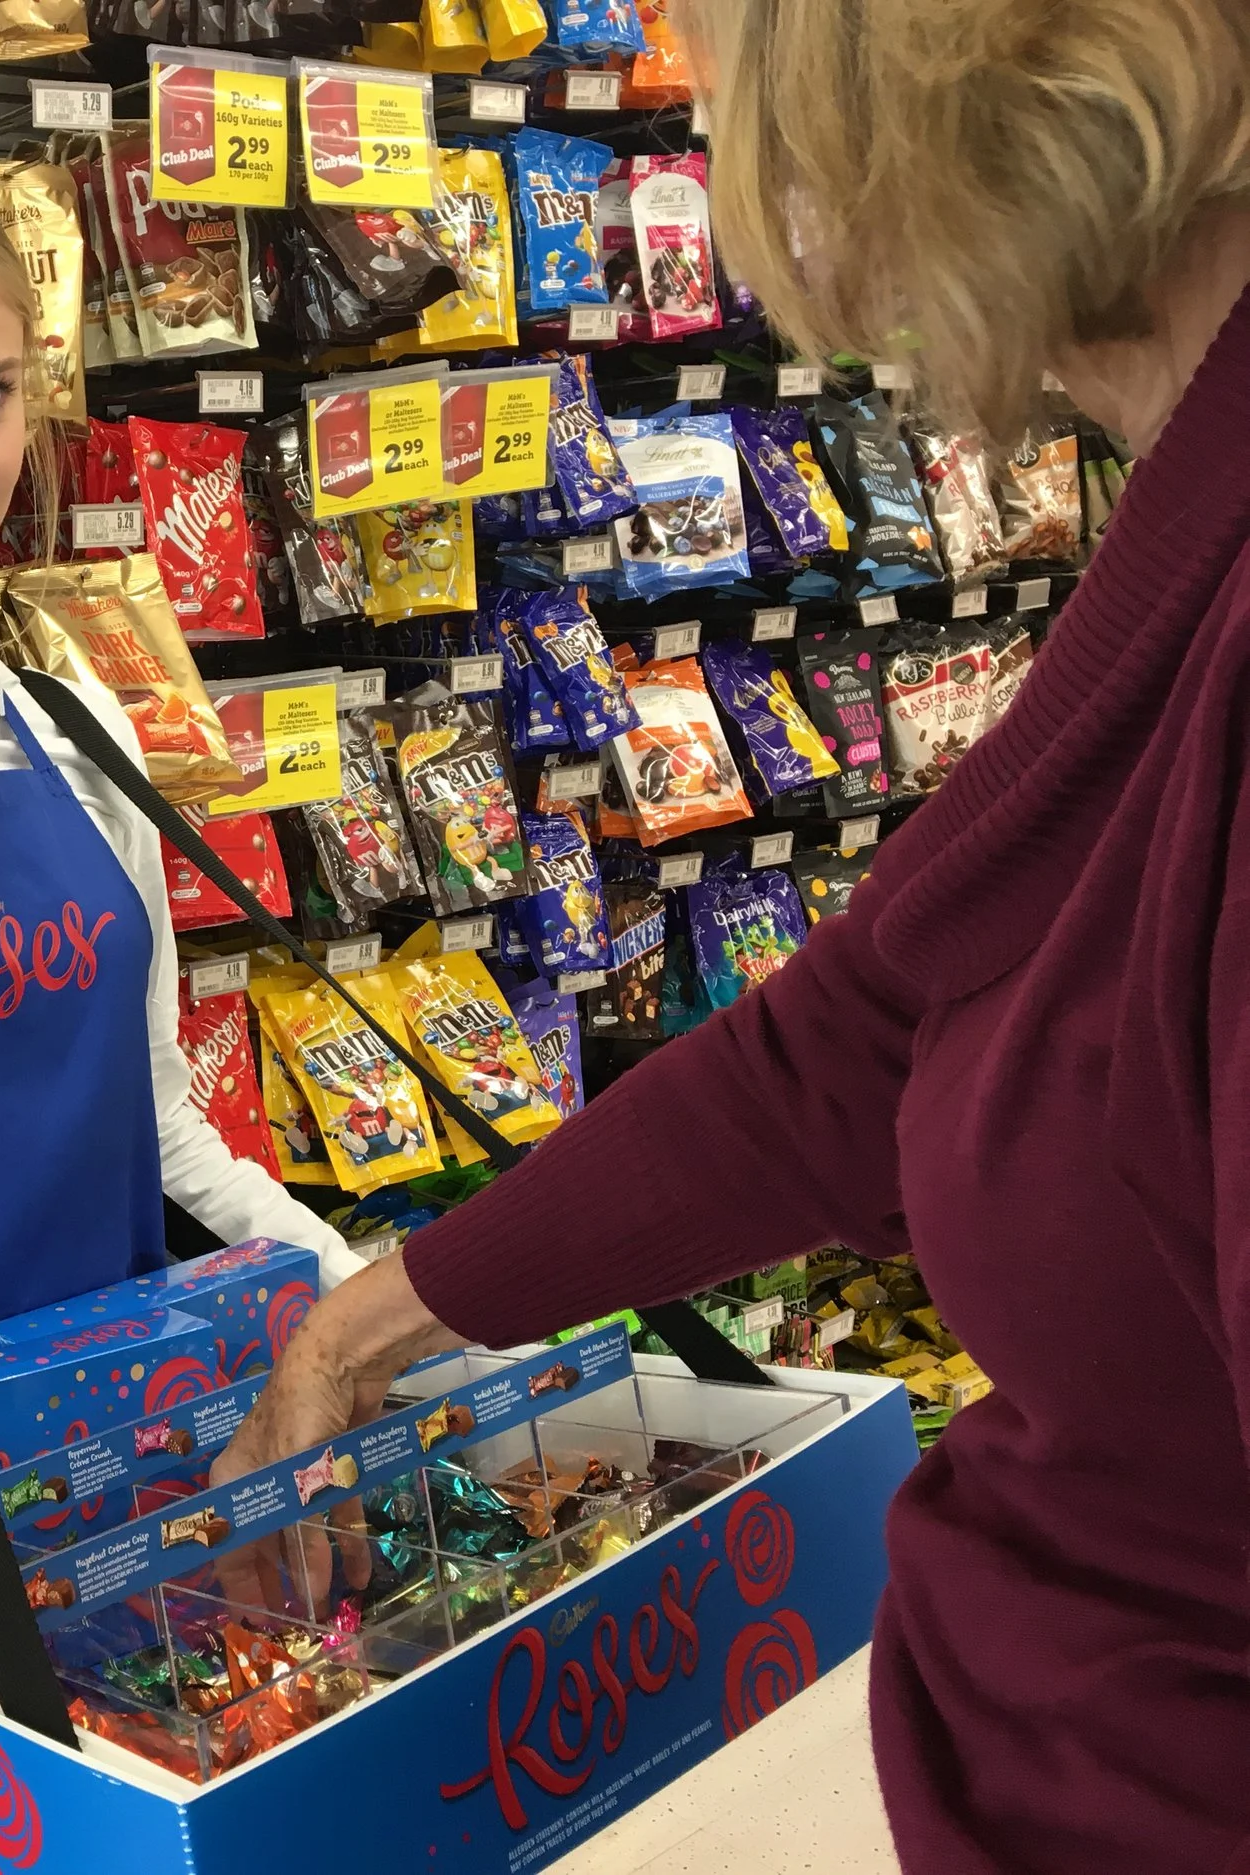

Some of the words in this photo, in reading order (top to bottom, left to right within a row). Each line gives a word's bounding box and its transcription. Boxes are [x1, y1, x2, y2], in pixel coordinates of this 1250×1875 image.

[82, 92, 101, 112] 5.29
[216, 111, 239, 126] 160g
[241, 114, 283, 129] Varieties
[161, 149, 187, 166] Club
[188, 145, 214, 162] Deal
[313, 155, 338, 172] Club
[338, 150, 360, 167] Deal
[248, 160, 273, 172] each
[255, 170, 269, 181] 100g
[186, 219, 237, 242] Mars
[403, 458, 429, 472] each
[461, 446, 483, 466] Deal
[511, 450, 535, 462] each
[321, 467, 347, 488] Club
[346, 458, 370, 476] Deal
[116, 511, 134, 529] 5.29
[80, 629, 150, 659] DARK
[88, 655, 174, 686] ORANGE
[895, 679, 990, 722] RASPBERRY
[836, 702, 876, 727] ROCKY
[241, 758, 265, 776] Deal
[300, 760, 327, 772] each
[579, 1346, 592, 1358] Dark
[473, 1387, 492, 1401] Turkish
[193, 1404, 219, 1419] Hazelnut
[218, 1396, 236, 1411] Swirl
[359, 1433, 378, 1449] White
[377, 1425, 408, 1444] Raspberry
[67, 1440, 102, 1460] Peppermint
[90, 1446, 113, 1465] Crunch
[231, 1487, 255, 1503] Vanilla
[75, 1548, 107, 1568] Hazelnut
[131, 1531, 150, 1547] Crisp
[440, 1558, 721, 1831] Roses
[690, 1718, 714, 1740] PEANUTS
[572, 1815, 593, 1833] OTHER
